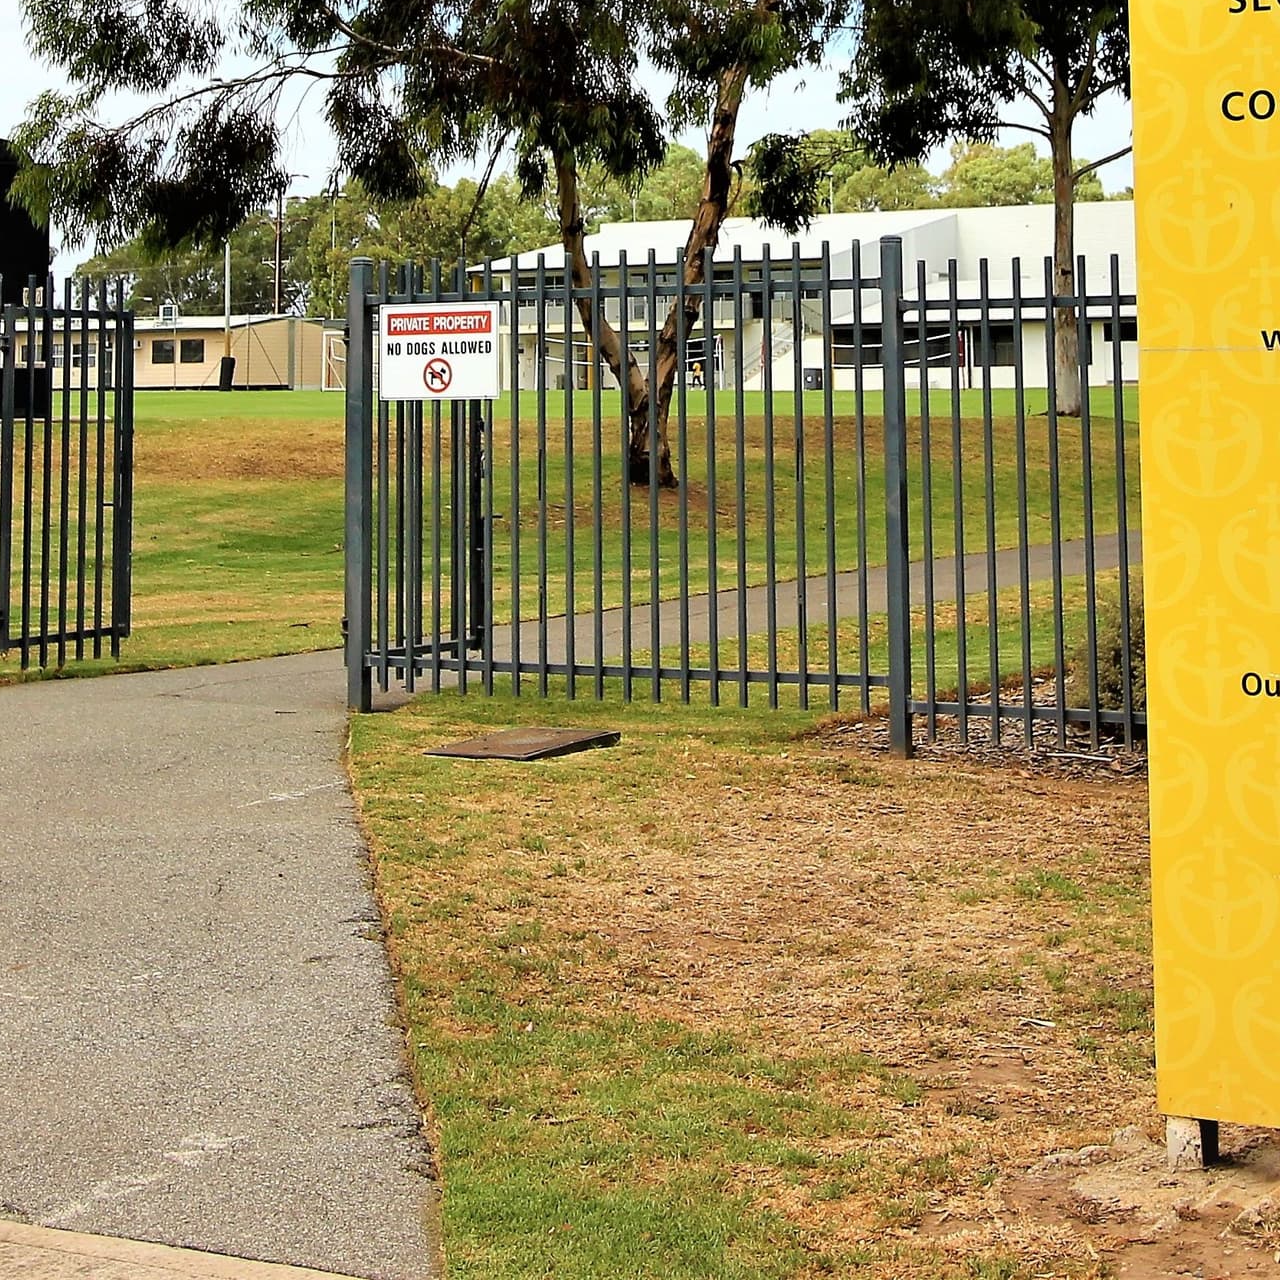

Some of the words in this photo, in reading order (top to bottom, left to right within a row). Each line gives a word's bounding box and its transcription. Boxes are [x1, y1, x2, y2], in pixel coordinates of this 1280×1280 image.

[391, 317, 429, 331] PRIVATE
[433, 316, 488, 330] PROPERTY
[387, 342, 401, 356] NO
[406, 342, 436, 356] DOGS
[441, 340, 492, 355] ALLOWED
